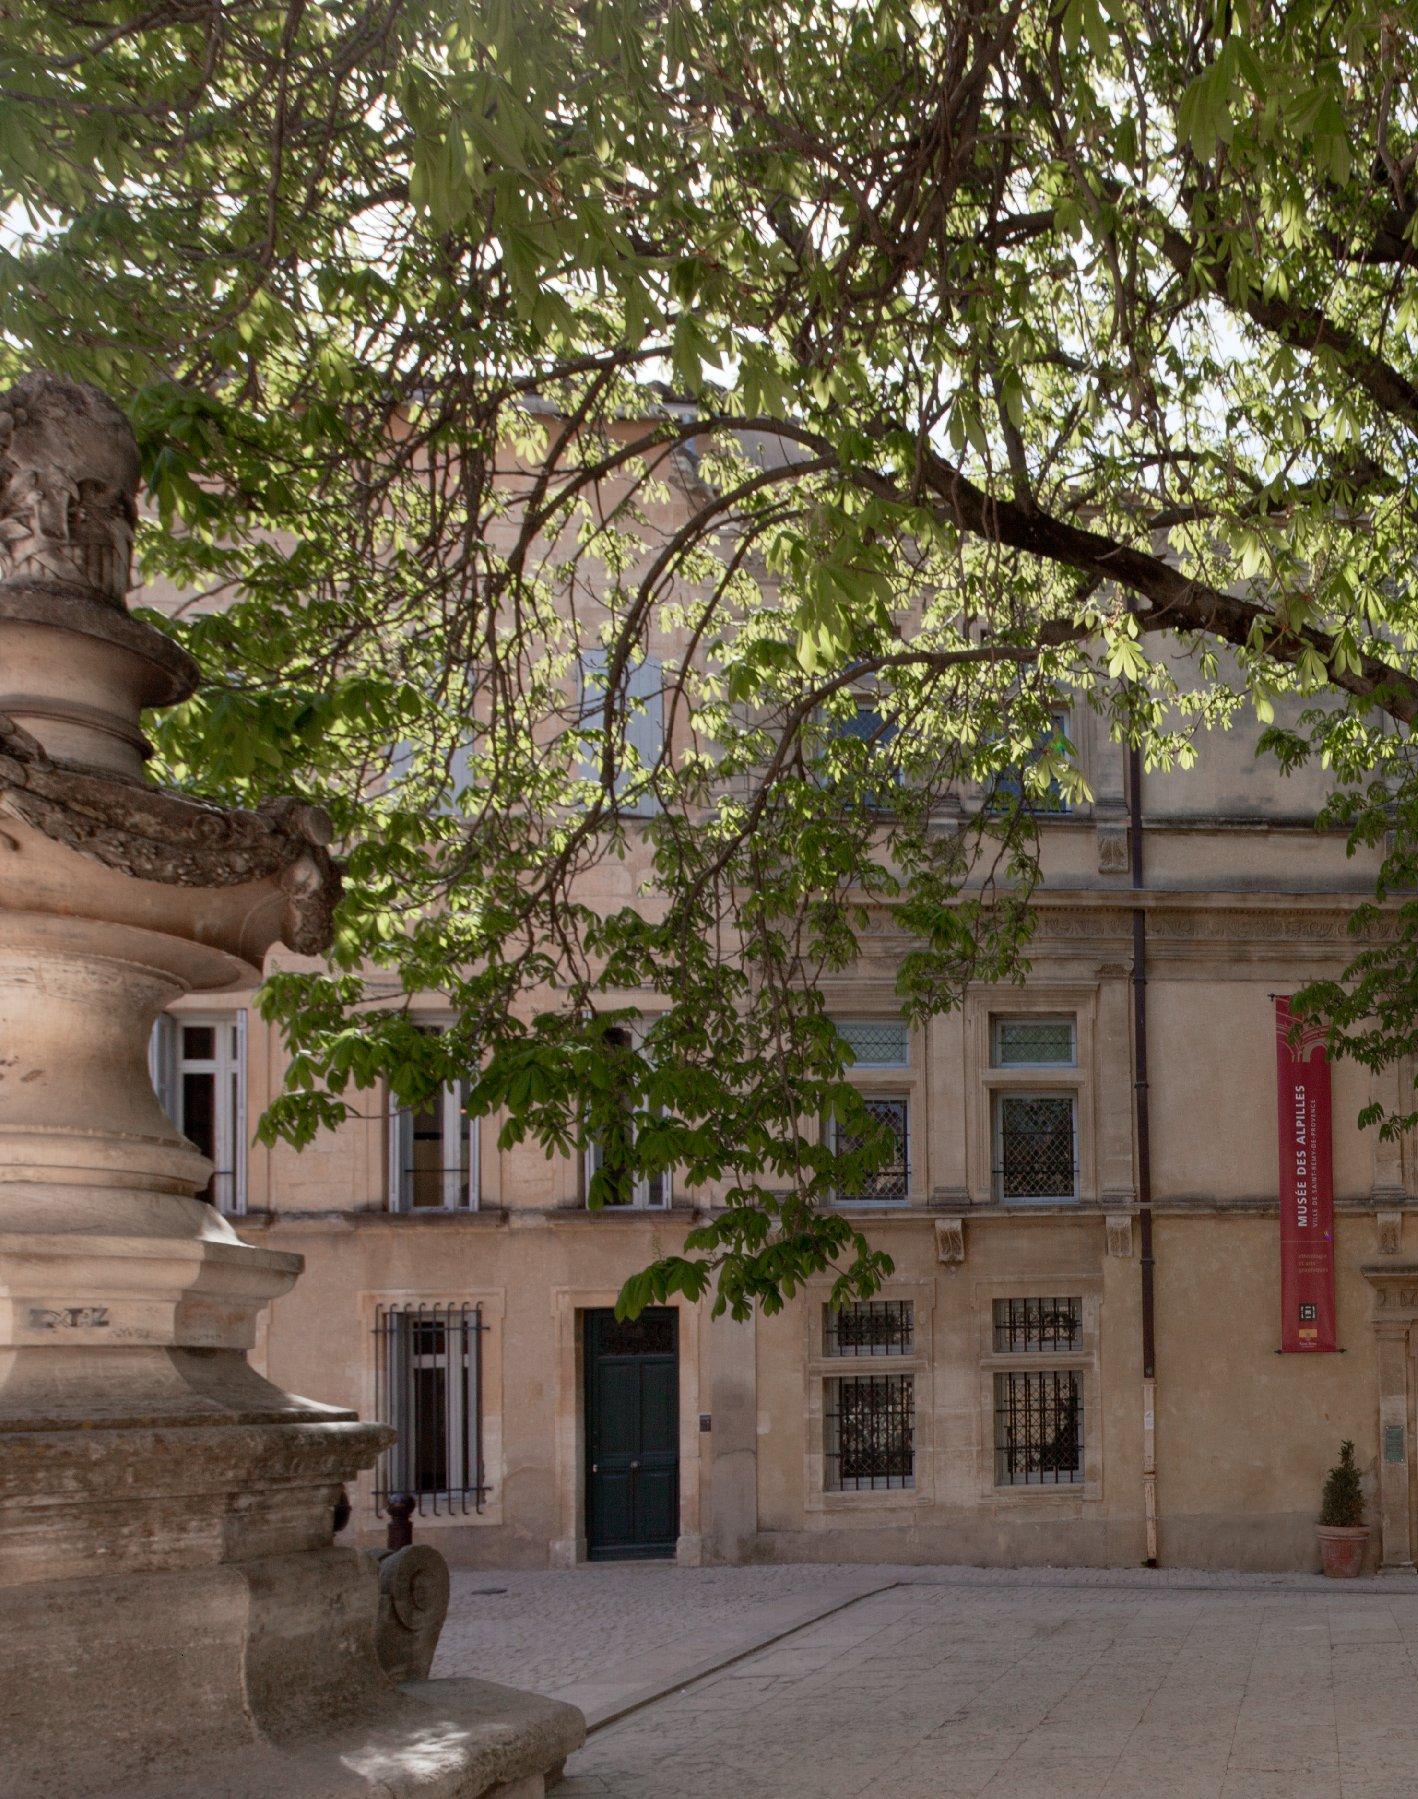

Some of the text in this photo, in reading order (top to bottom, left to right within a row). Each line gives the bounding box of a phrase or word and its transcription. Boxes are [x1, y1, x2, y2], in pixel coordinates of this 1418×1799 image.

[1295, 1085, 1308, 1227] MUSÉE DES ALPILLES
[1311, 1196, 1318, 1206] DE
